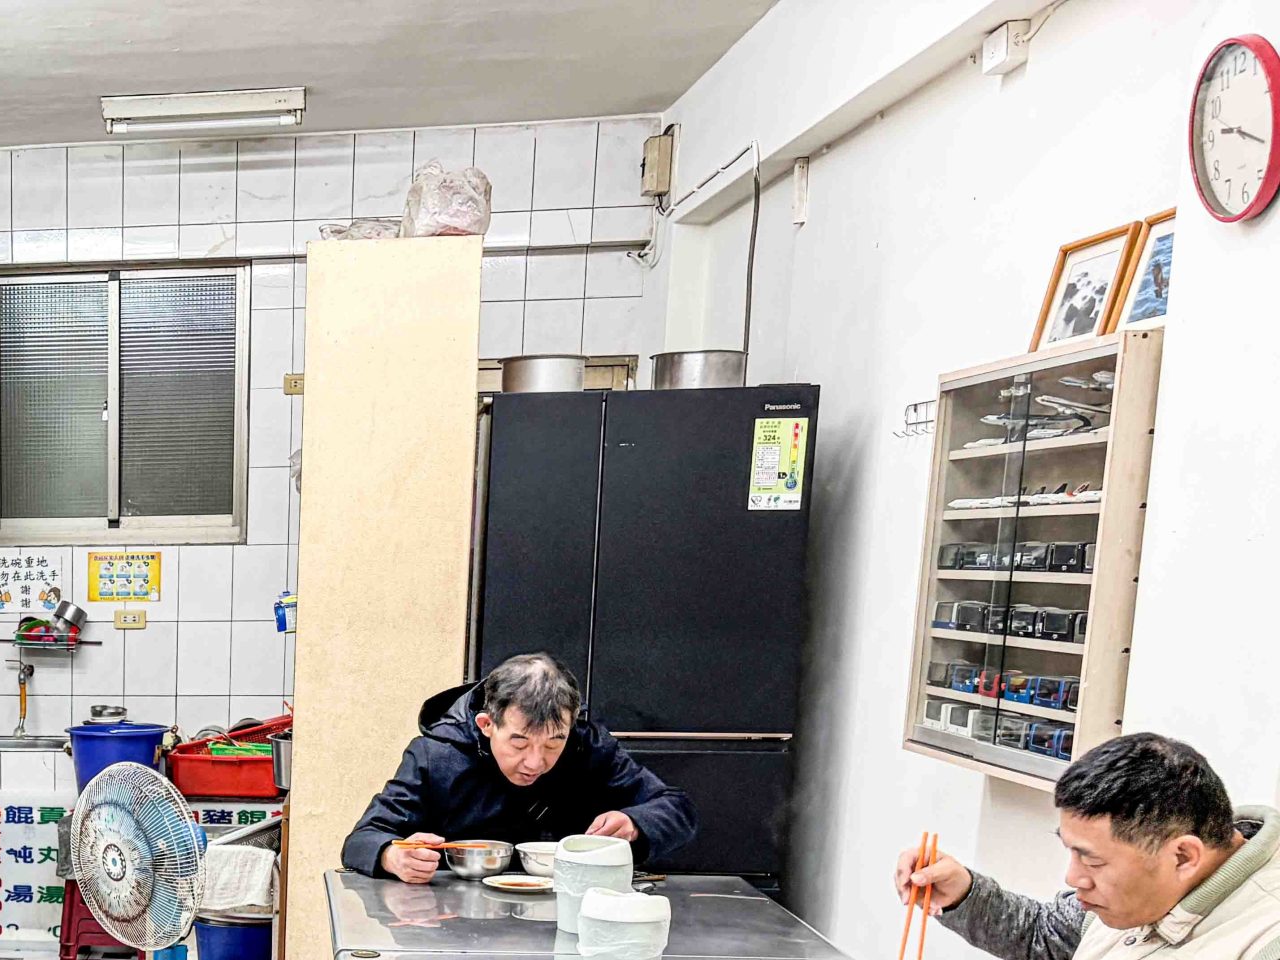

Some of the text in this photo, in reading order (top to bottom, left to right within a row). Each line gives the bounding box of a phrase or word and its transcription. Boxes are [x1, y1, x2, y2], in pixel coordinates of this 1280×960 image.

[1233, 52, 1246, 76] 12
[1220, 68, 1230, 91] 11
[1211, 96, 1221, 120] 10
[1207, 130, 1215, 150] 9
[1213, 160, 1220, 181] 8
[1225, 179, 1232, 201] 7
[1241, 182, 1249, 204] 6
[764, 403, 801, 411] Panasonic
[20, 585, 31, 608] 謝謝
